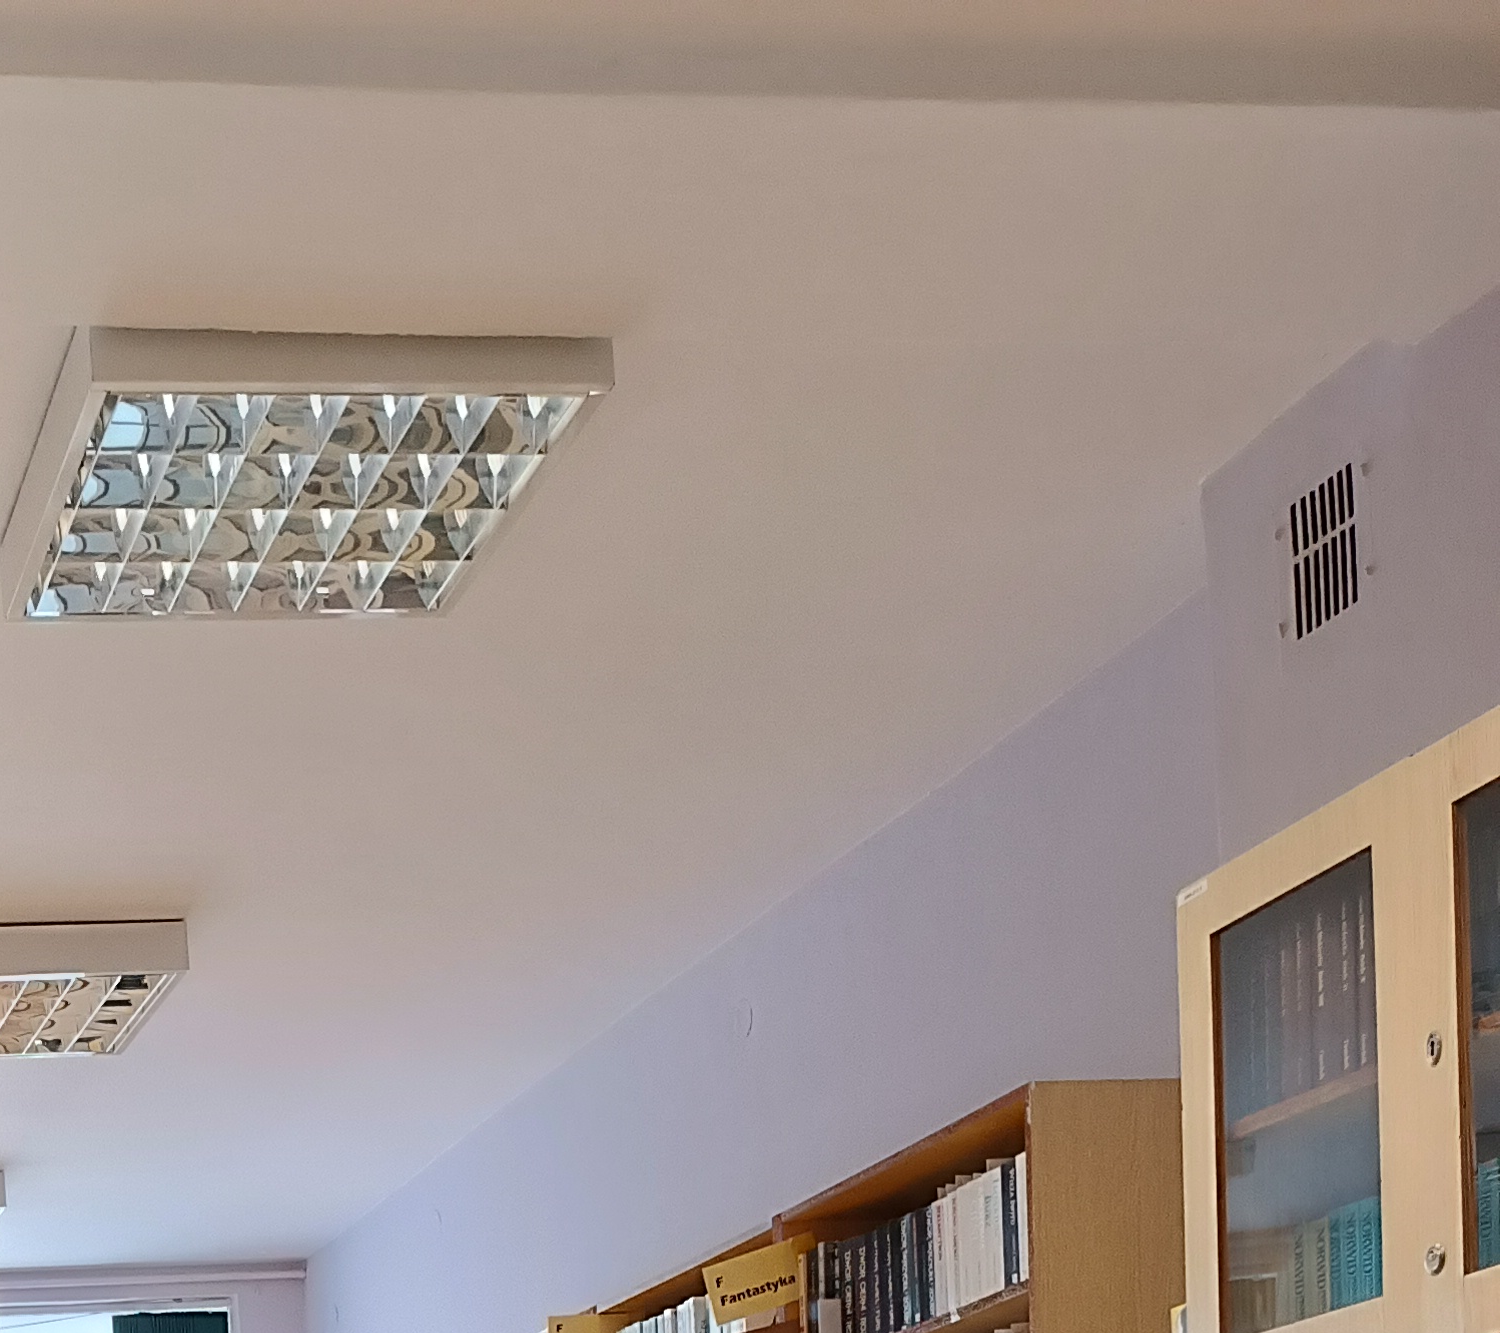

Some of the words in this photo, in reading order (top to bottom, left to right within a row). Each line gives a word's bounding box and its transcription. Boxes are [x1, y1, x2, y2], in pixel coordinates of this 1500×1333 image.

[1317, 1226, 1326, 1290] NORWID
[1362, 1210, 1373, 1275] NORWID
[715, 1276, 724, 1289] F
[720, 1273, 796, 1307] Fantastyka
[556, 1324, 563, 1333] F
